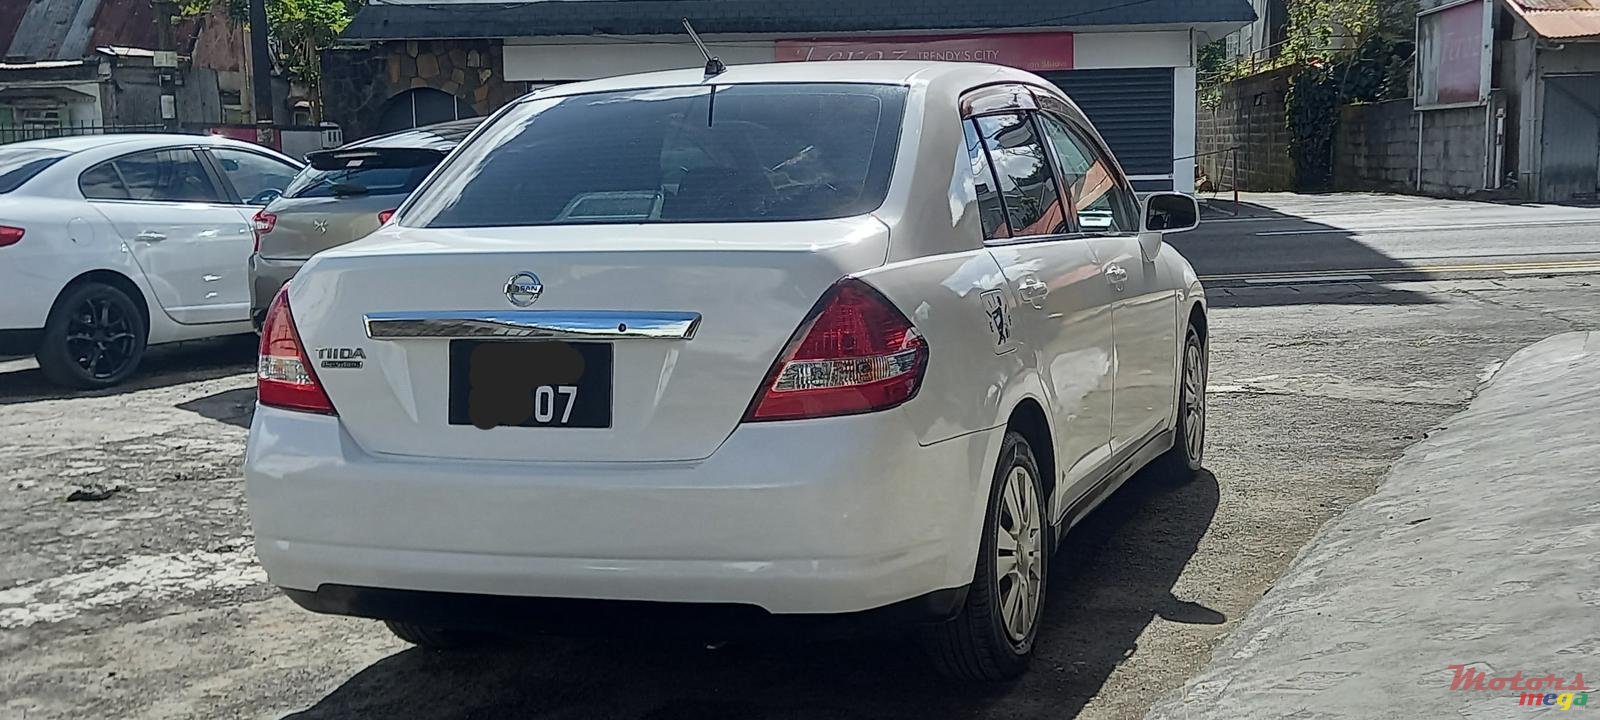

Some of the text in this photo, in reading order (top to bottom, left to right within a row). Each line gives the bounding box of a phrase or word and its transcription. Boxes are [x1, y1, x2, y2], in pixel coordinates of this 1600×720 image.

[918, 50, 1000, 61] TRENDY'S CITY
[315, 347, 366, 360] TIIDA
[534, 386, 578, 423] 07
